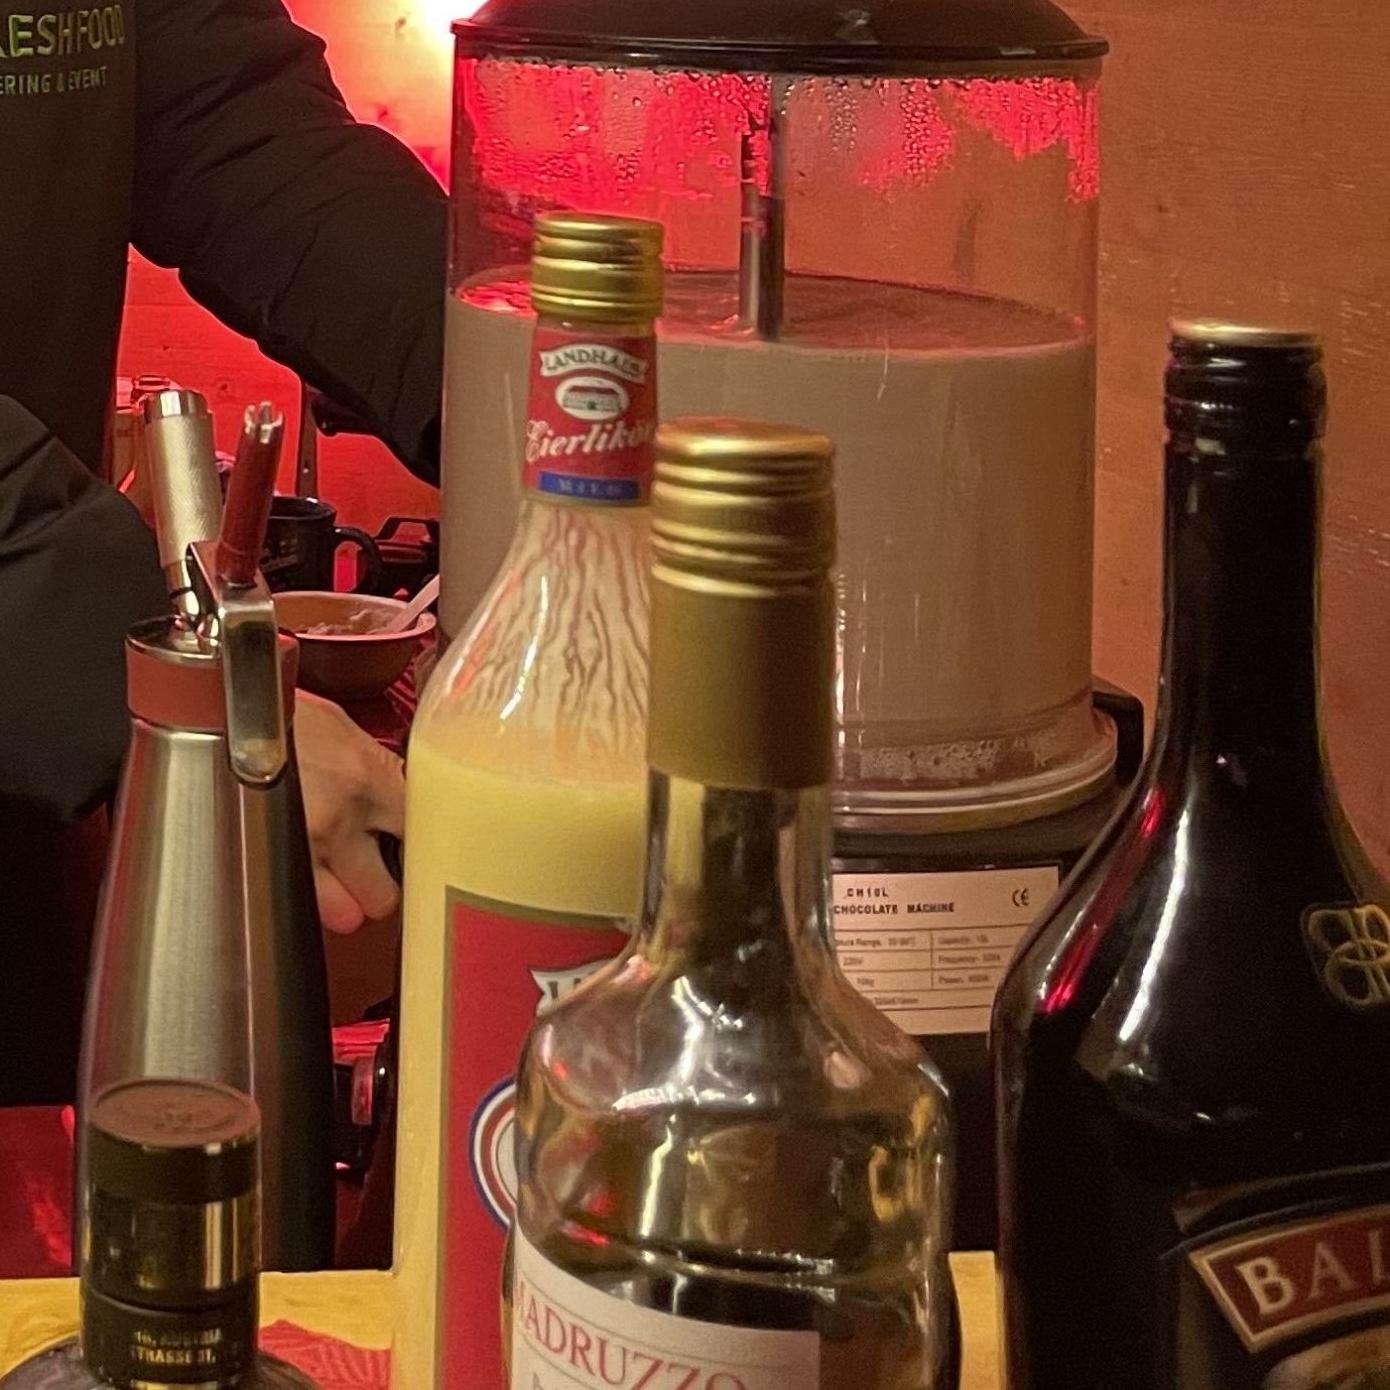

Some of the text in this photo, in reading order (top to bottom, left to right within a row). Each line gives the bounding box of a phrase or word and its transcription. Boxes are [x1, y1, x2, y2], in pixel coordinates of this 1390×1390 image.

[68, 65, 108, 90] EVENT
[833, 902, 955, 915] CHOCOLATE MACHINE
